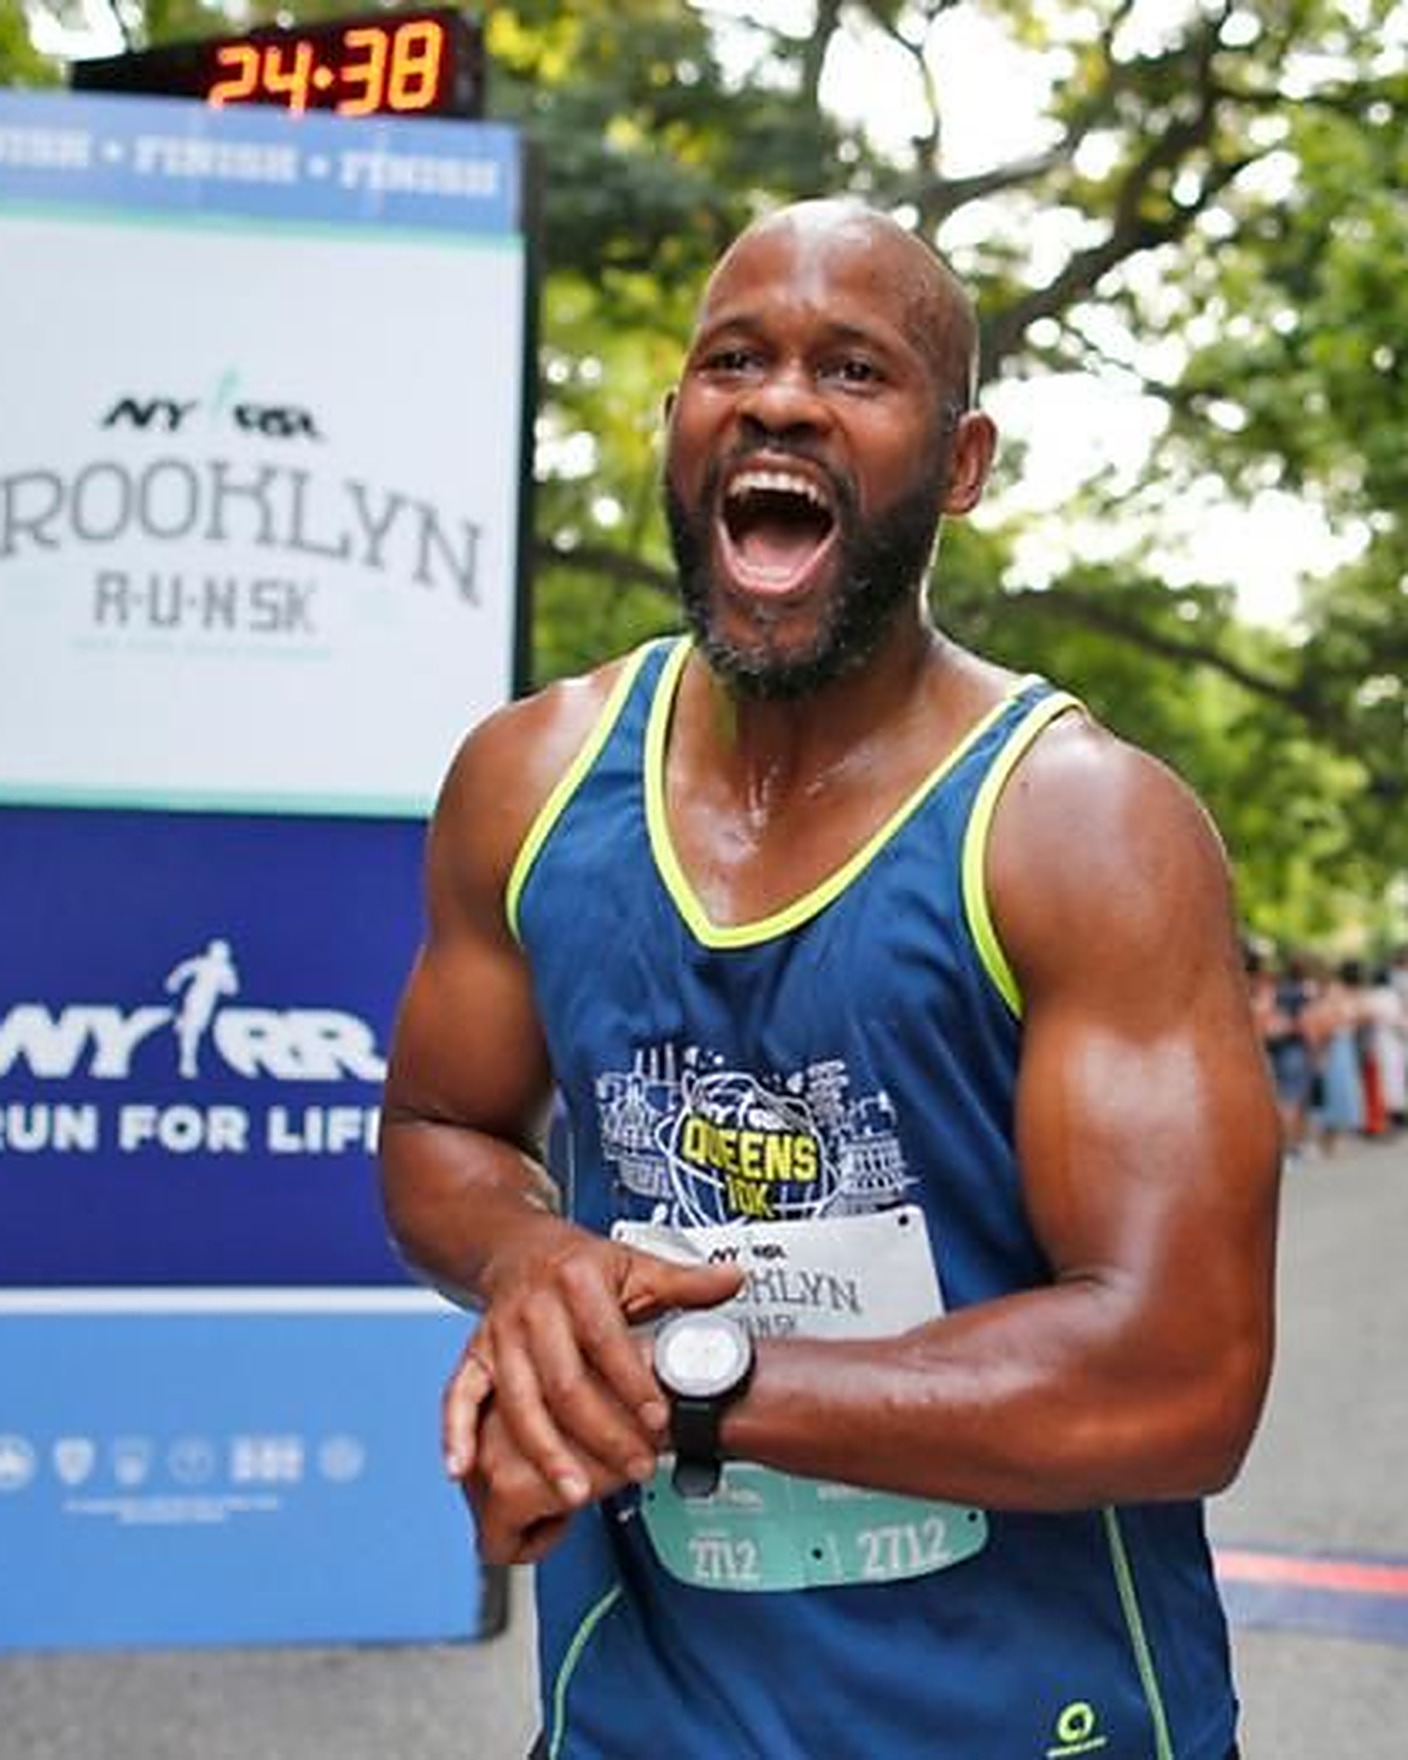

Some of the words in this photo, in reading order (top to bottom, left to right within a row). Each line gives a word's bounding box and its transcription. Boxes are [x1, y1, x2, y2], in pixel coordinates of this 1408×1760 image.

[0, 1104, 98, 1153] UN
[118, 1104, 249, 1153] FOR
[681, 1116, 818, 1183] QUEENS
[856, 1517, 952, 1578] 2712
